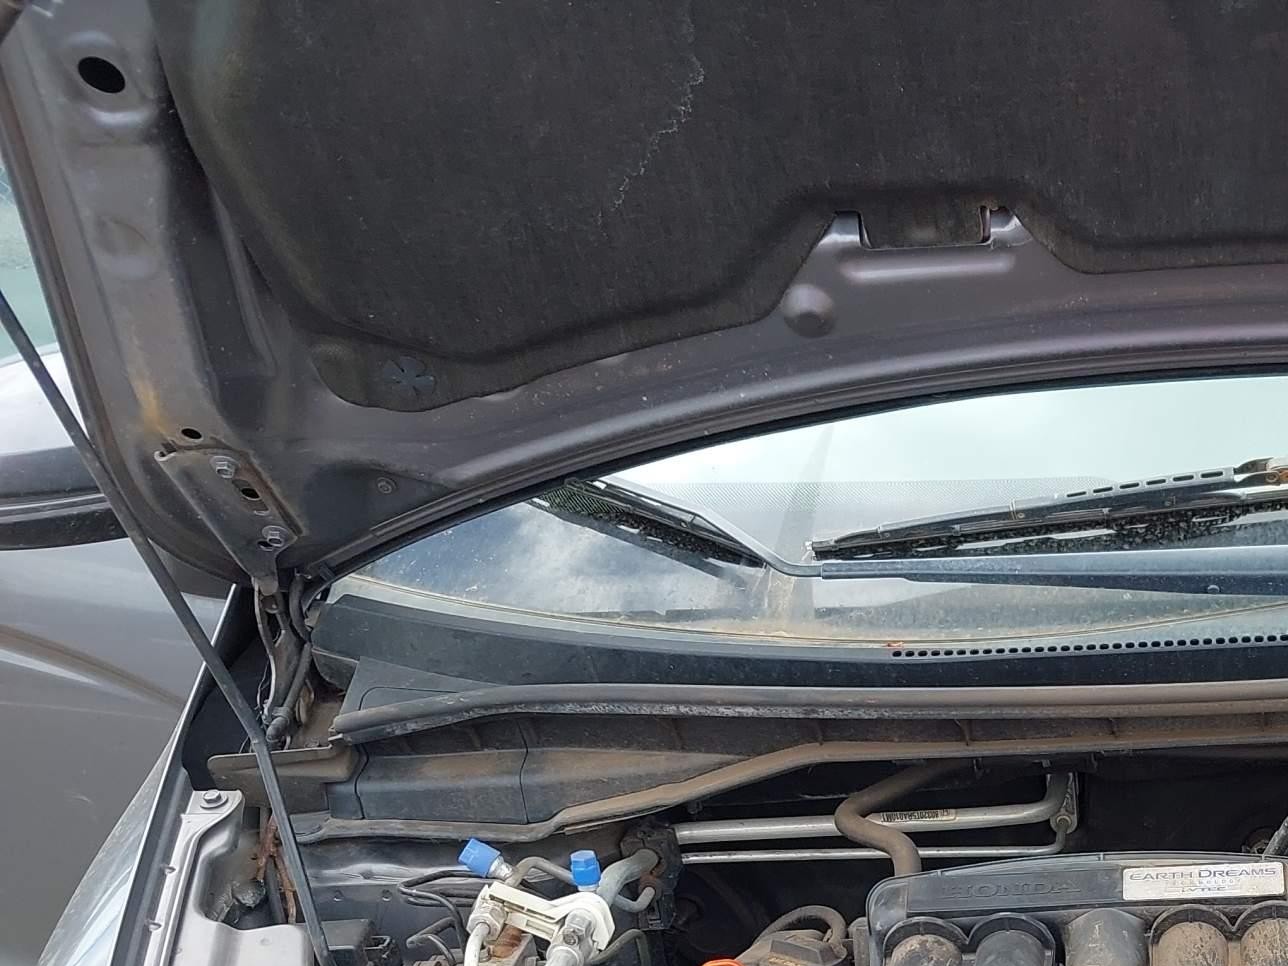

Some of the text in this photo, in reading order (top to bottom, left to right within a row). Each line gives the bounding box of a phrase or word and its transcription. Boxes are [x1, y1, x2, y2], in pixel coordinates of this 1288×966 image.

[1129, 867, 1276, 880] EARTH DREAMS
[940, 881, 1081, 898] HONDA
